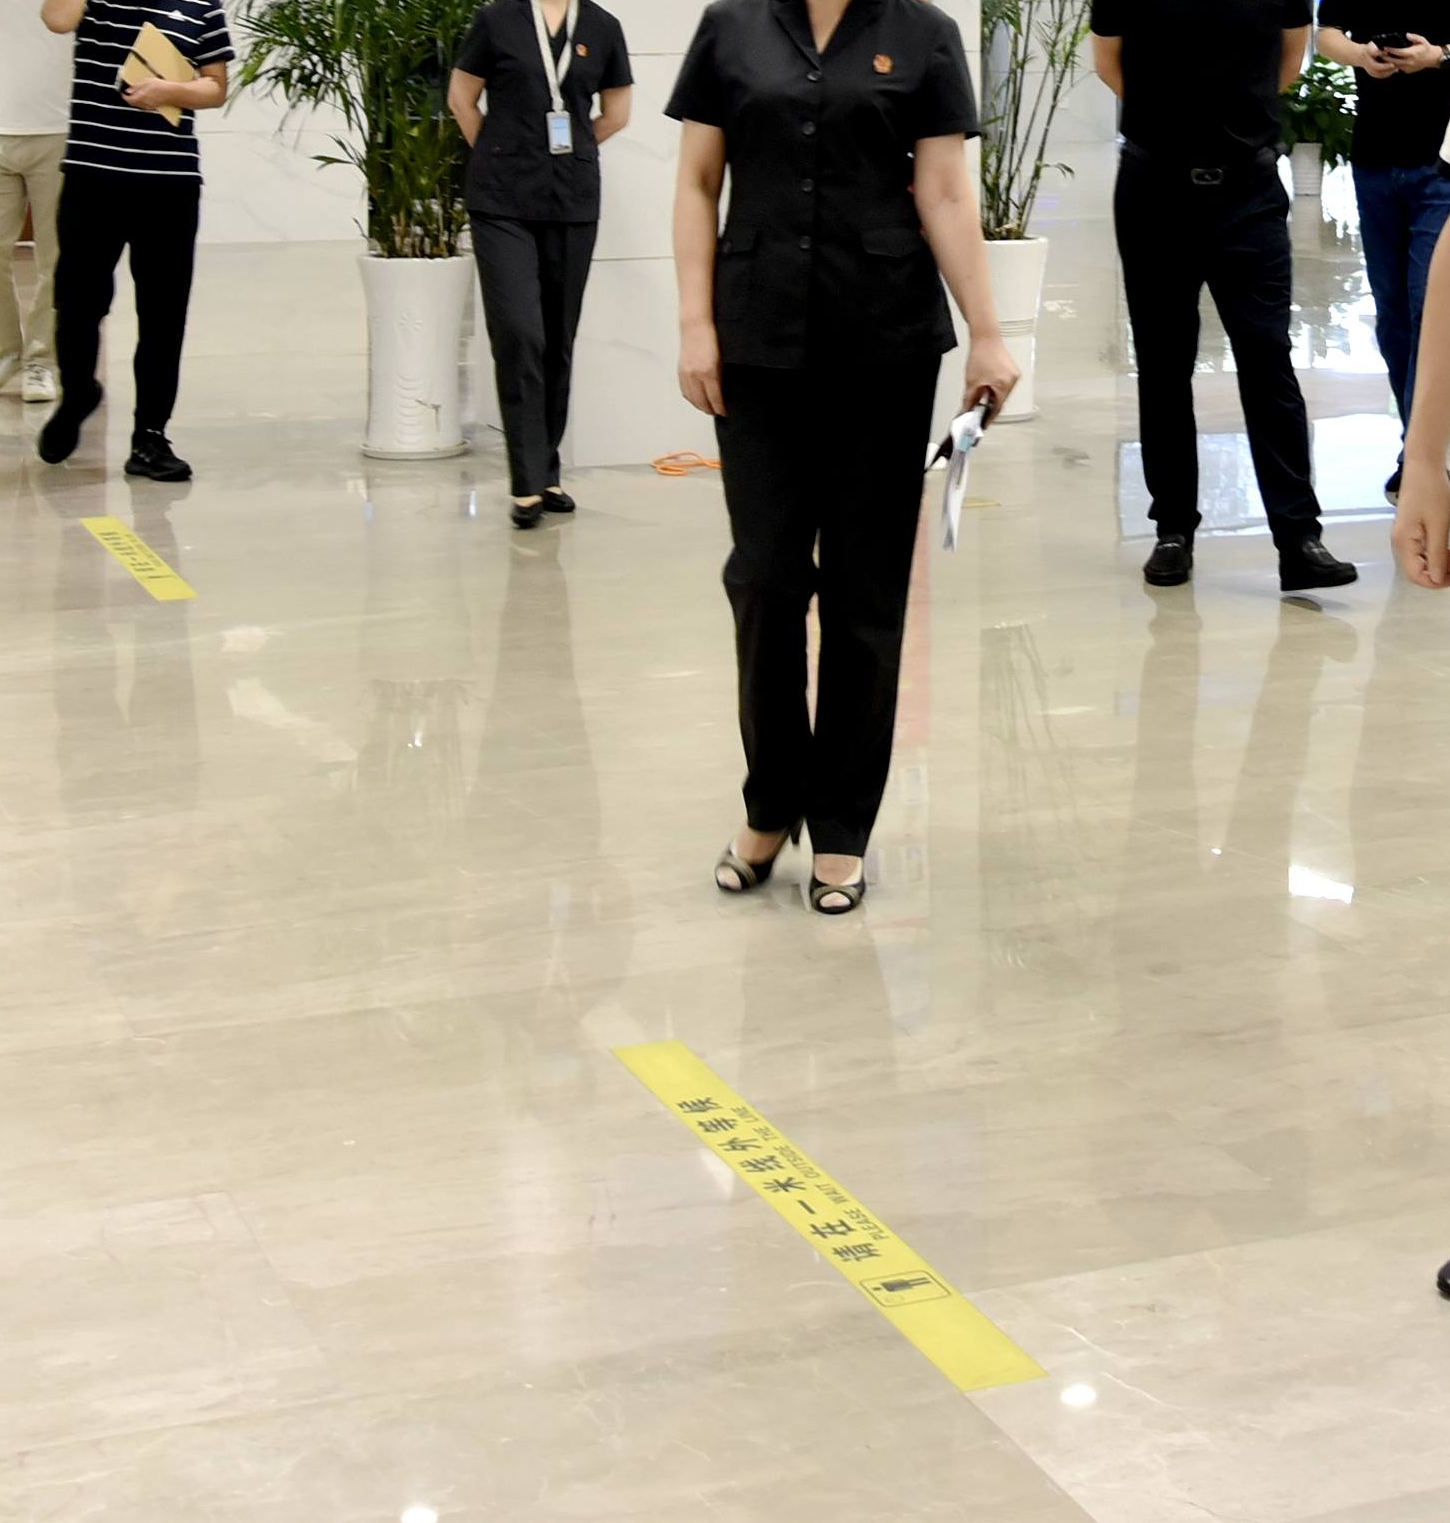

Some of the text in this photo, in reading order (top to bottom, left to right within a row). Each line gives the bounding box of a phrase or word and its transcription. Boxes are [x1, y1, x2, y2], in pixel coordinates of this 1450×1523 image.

[676, 1097, 882, 1262] 请在一米线外等候
[730, 1105, 889, 1241] PLEASE WAIT OUTSIDE THE LINE
